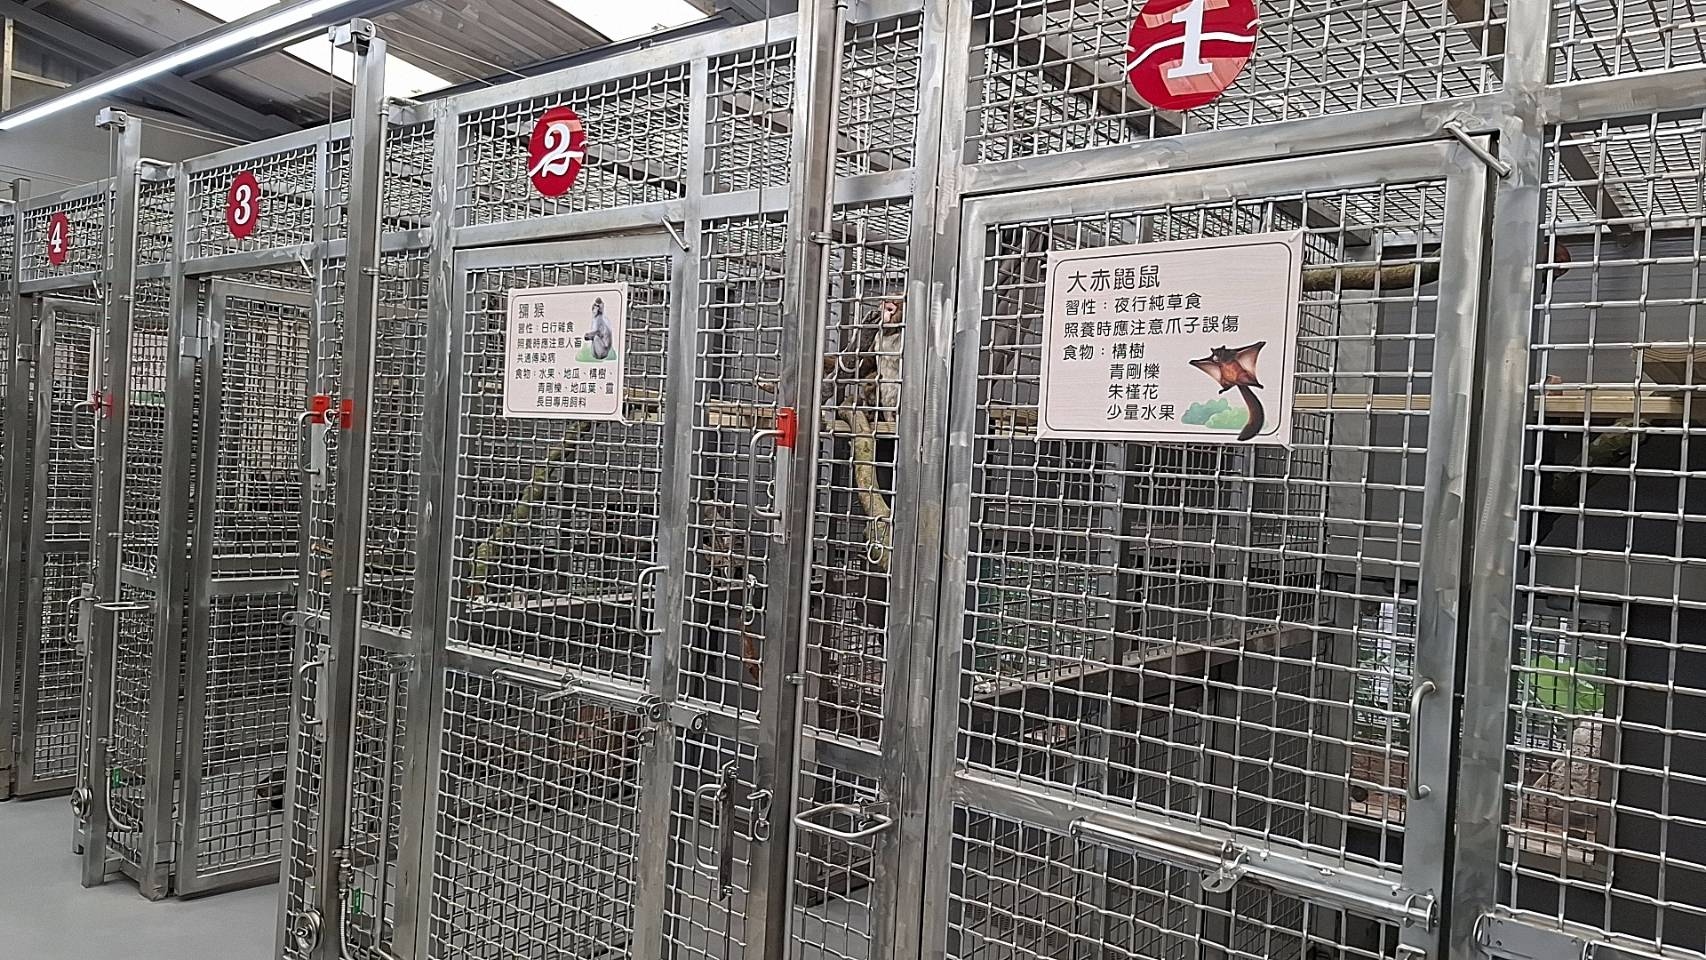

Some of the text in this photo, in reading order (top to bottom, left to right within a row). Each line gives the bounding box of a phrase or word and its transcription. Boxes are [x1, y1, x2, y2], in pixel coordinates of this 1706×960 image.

[1167, 0, 1213, 79] 1
[541, 123, 572, 177] 2
[233, 184, 252, 225] 3
[50, 221, 62, 253] 4
[1066, 264, 1161, 294] 大赤鼯鼠
[1063, 315, 1240, 339] 照養時應注意爪子誤傷
[1109, 363, 1161, 380] 青剛櫟
[1107, 383, 1159, 401] 朱槿花
[1106, 404, 1175, 421] 少量水果
